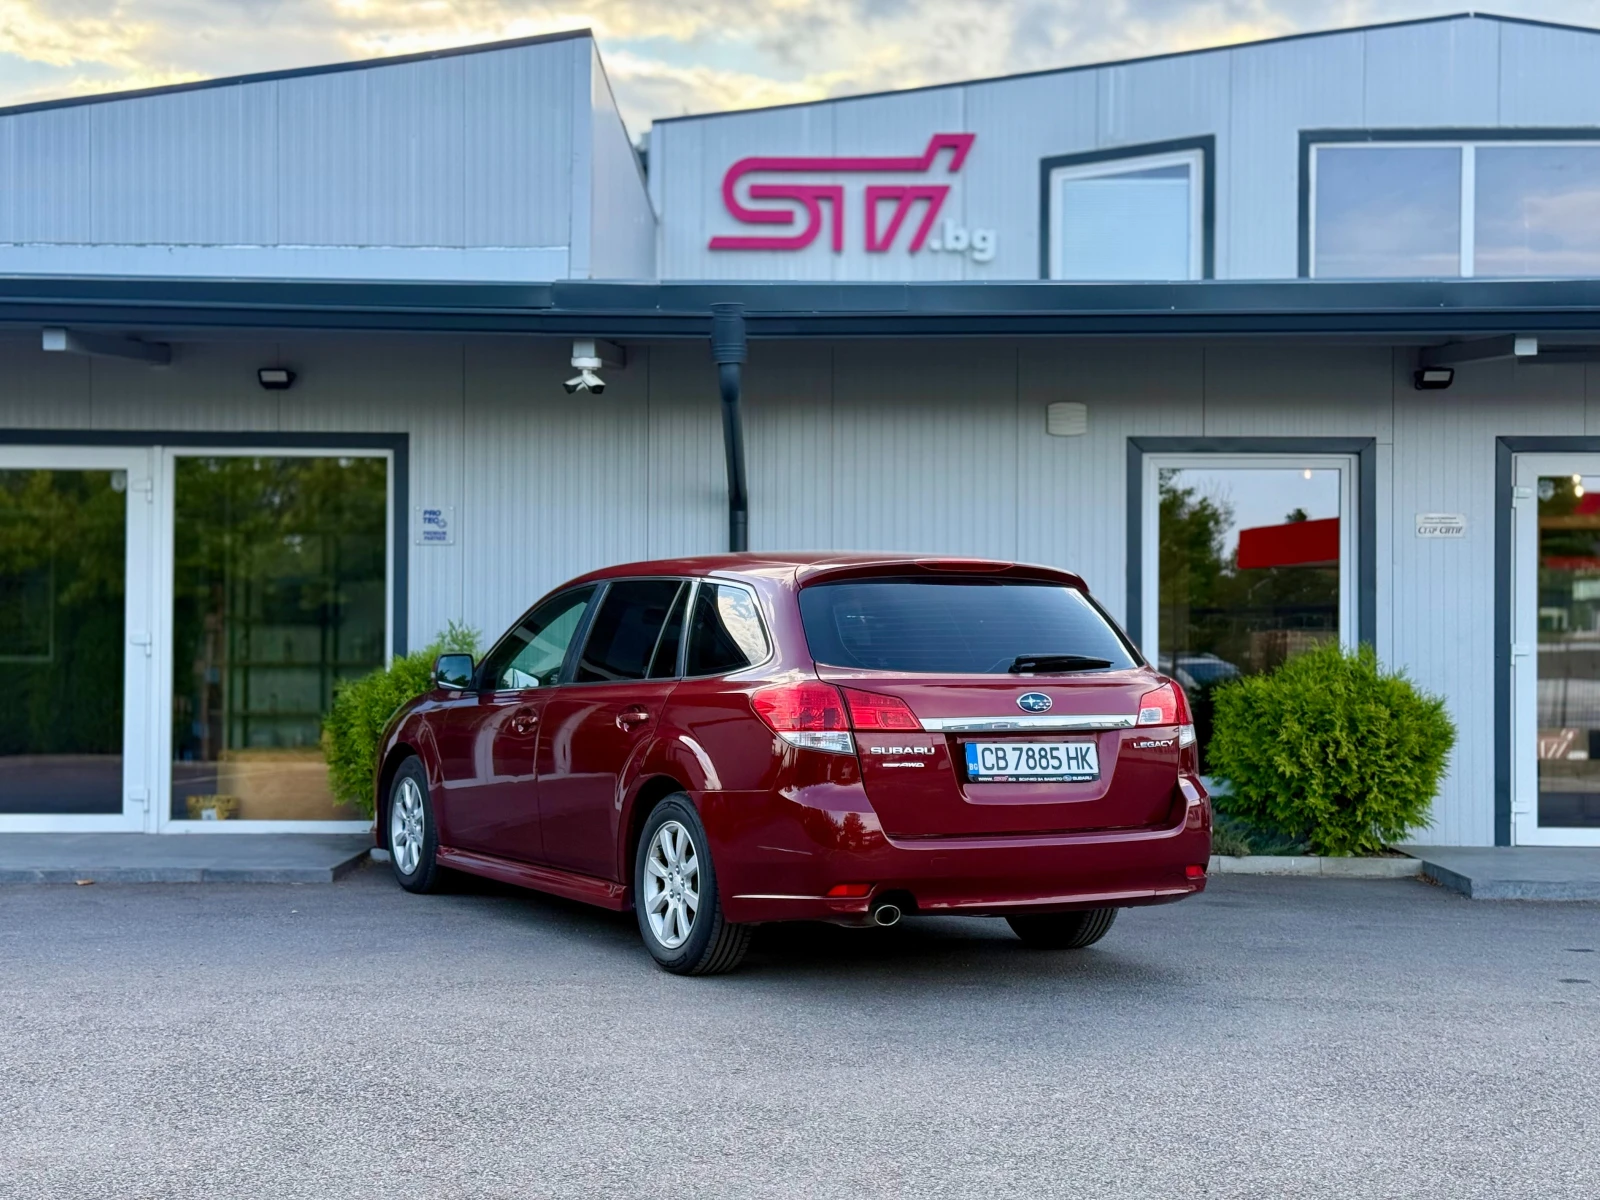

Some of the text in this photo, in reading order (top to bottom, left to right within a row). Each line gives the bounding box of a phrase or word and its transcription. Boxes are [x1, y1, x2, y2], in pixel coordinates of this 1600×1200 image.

[1133, 740, 1173, 749] LEGACY
[870, 746, 935, 755] SUBARU
[969, 763, 979, 771] BG
